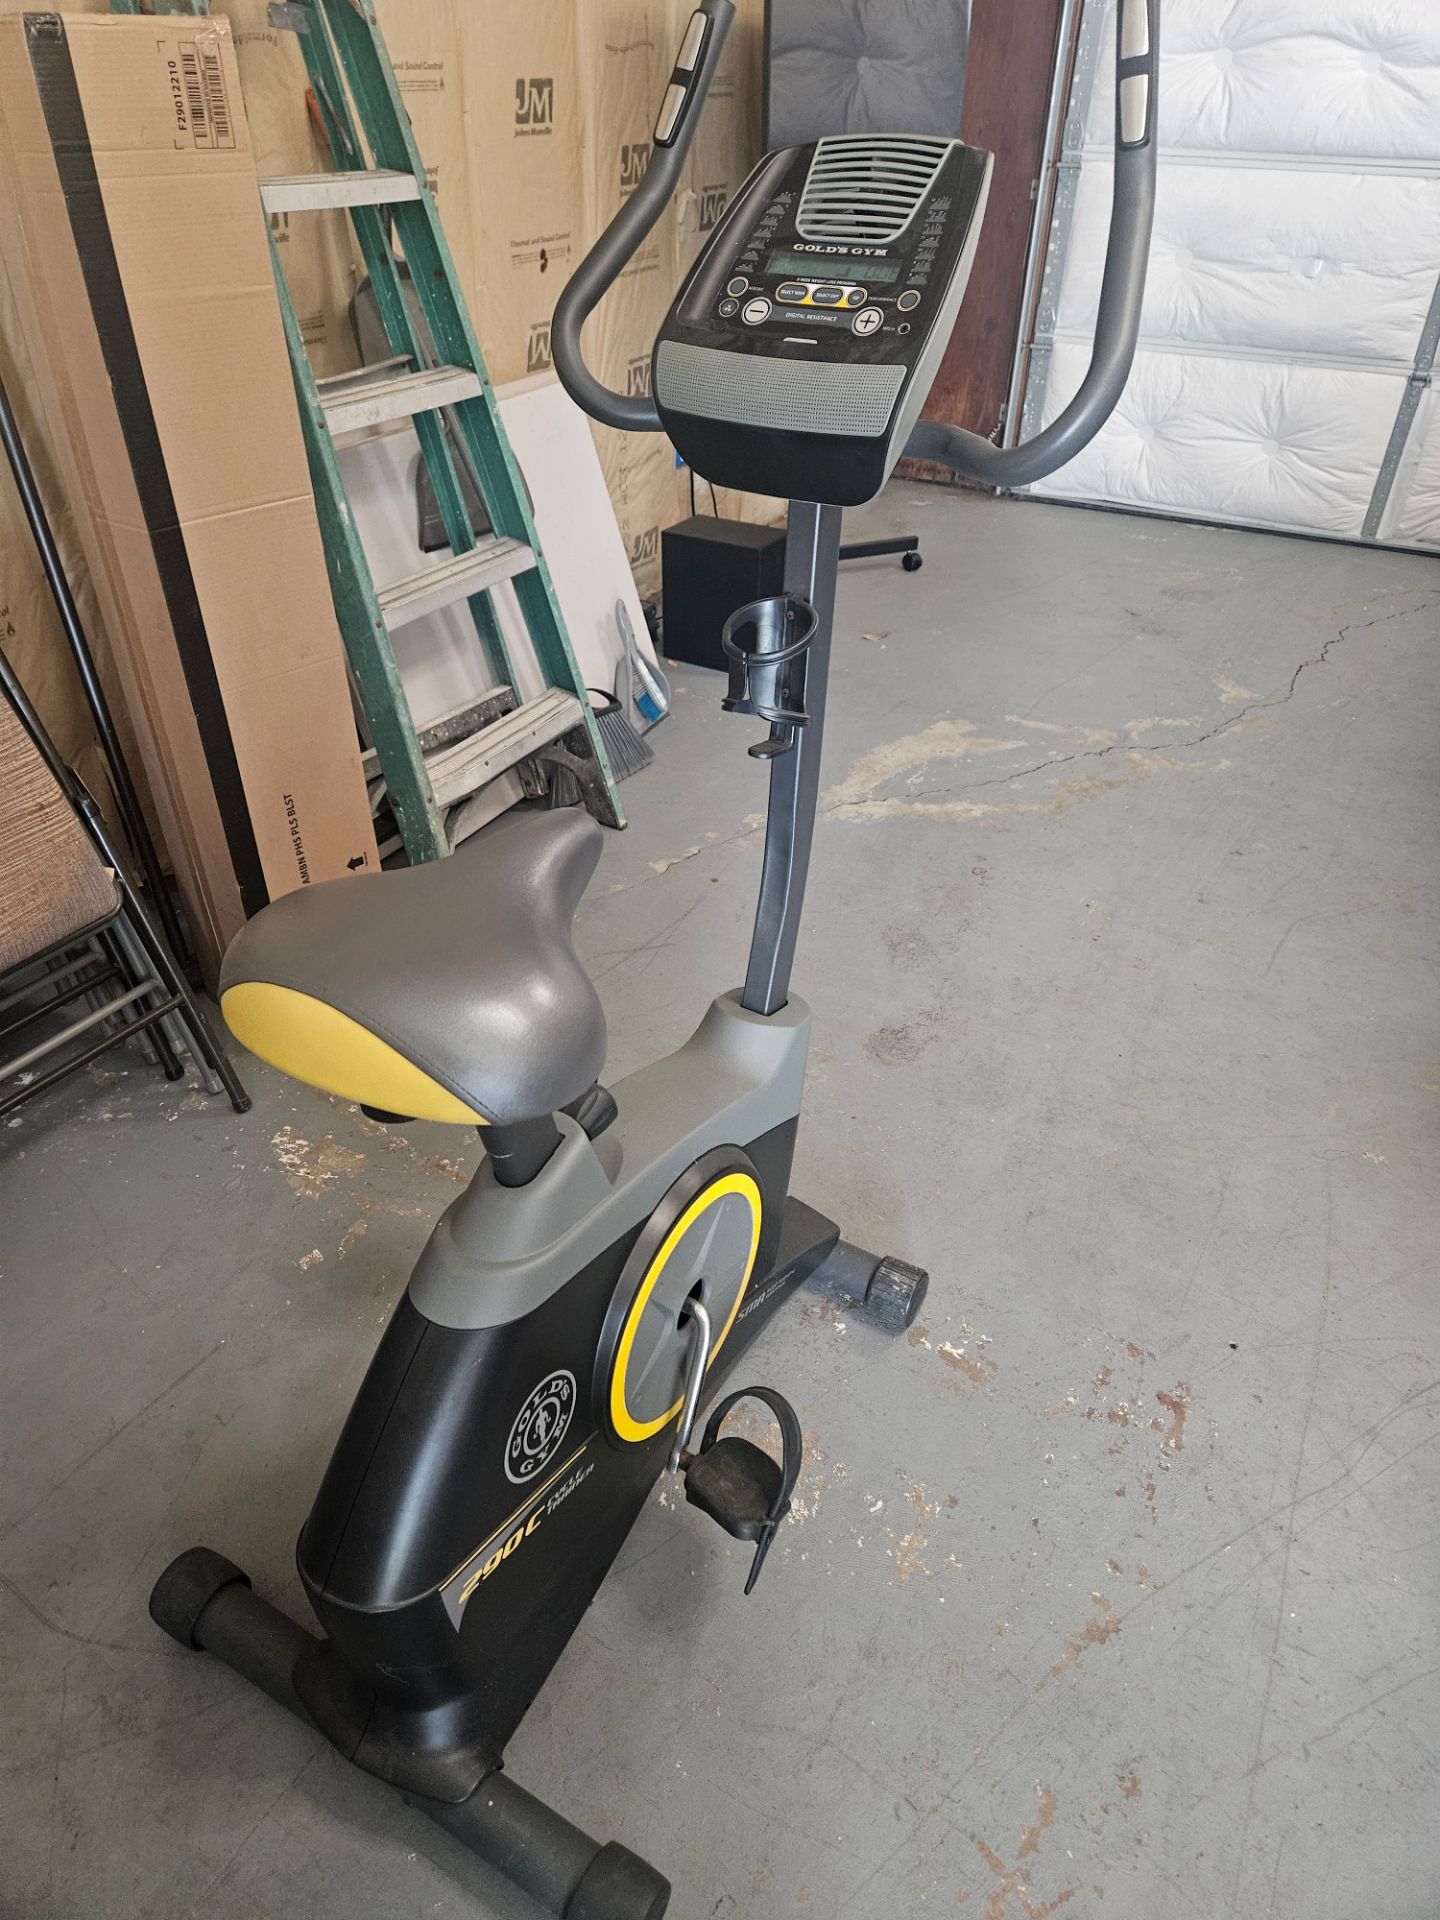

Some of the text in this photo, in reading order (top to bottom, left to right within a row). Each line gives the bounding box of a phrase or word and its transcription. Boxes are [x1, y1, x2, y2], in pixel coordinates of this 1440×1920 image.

[167, 60, 188, 131] F29012210
[514, 77, 554, 125] JM
[793, 243, 888, 257] GOLD'S GYM
[785, 312, 838, 322] DIGITAL RESISTANCE
[283, 794, 311, 884] AMBN PHS PLS BLST
[512, 1379, 571, 1458] GOLD'S
[520, 1412, 569, 1474] GYM
[458, 1505, 546, 1605] 290C
